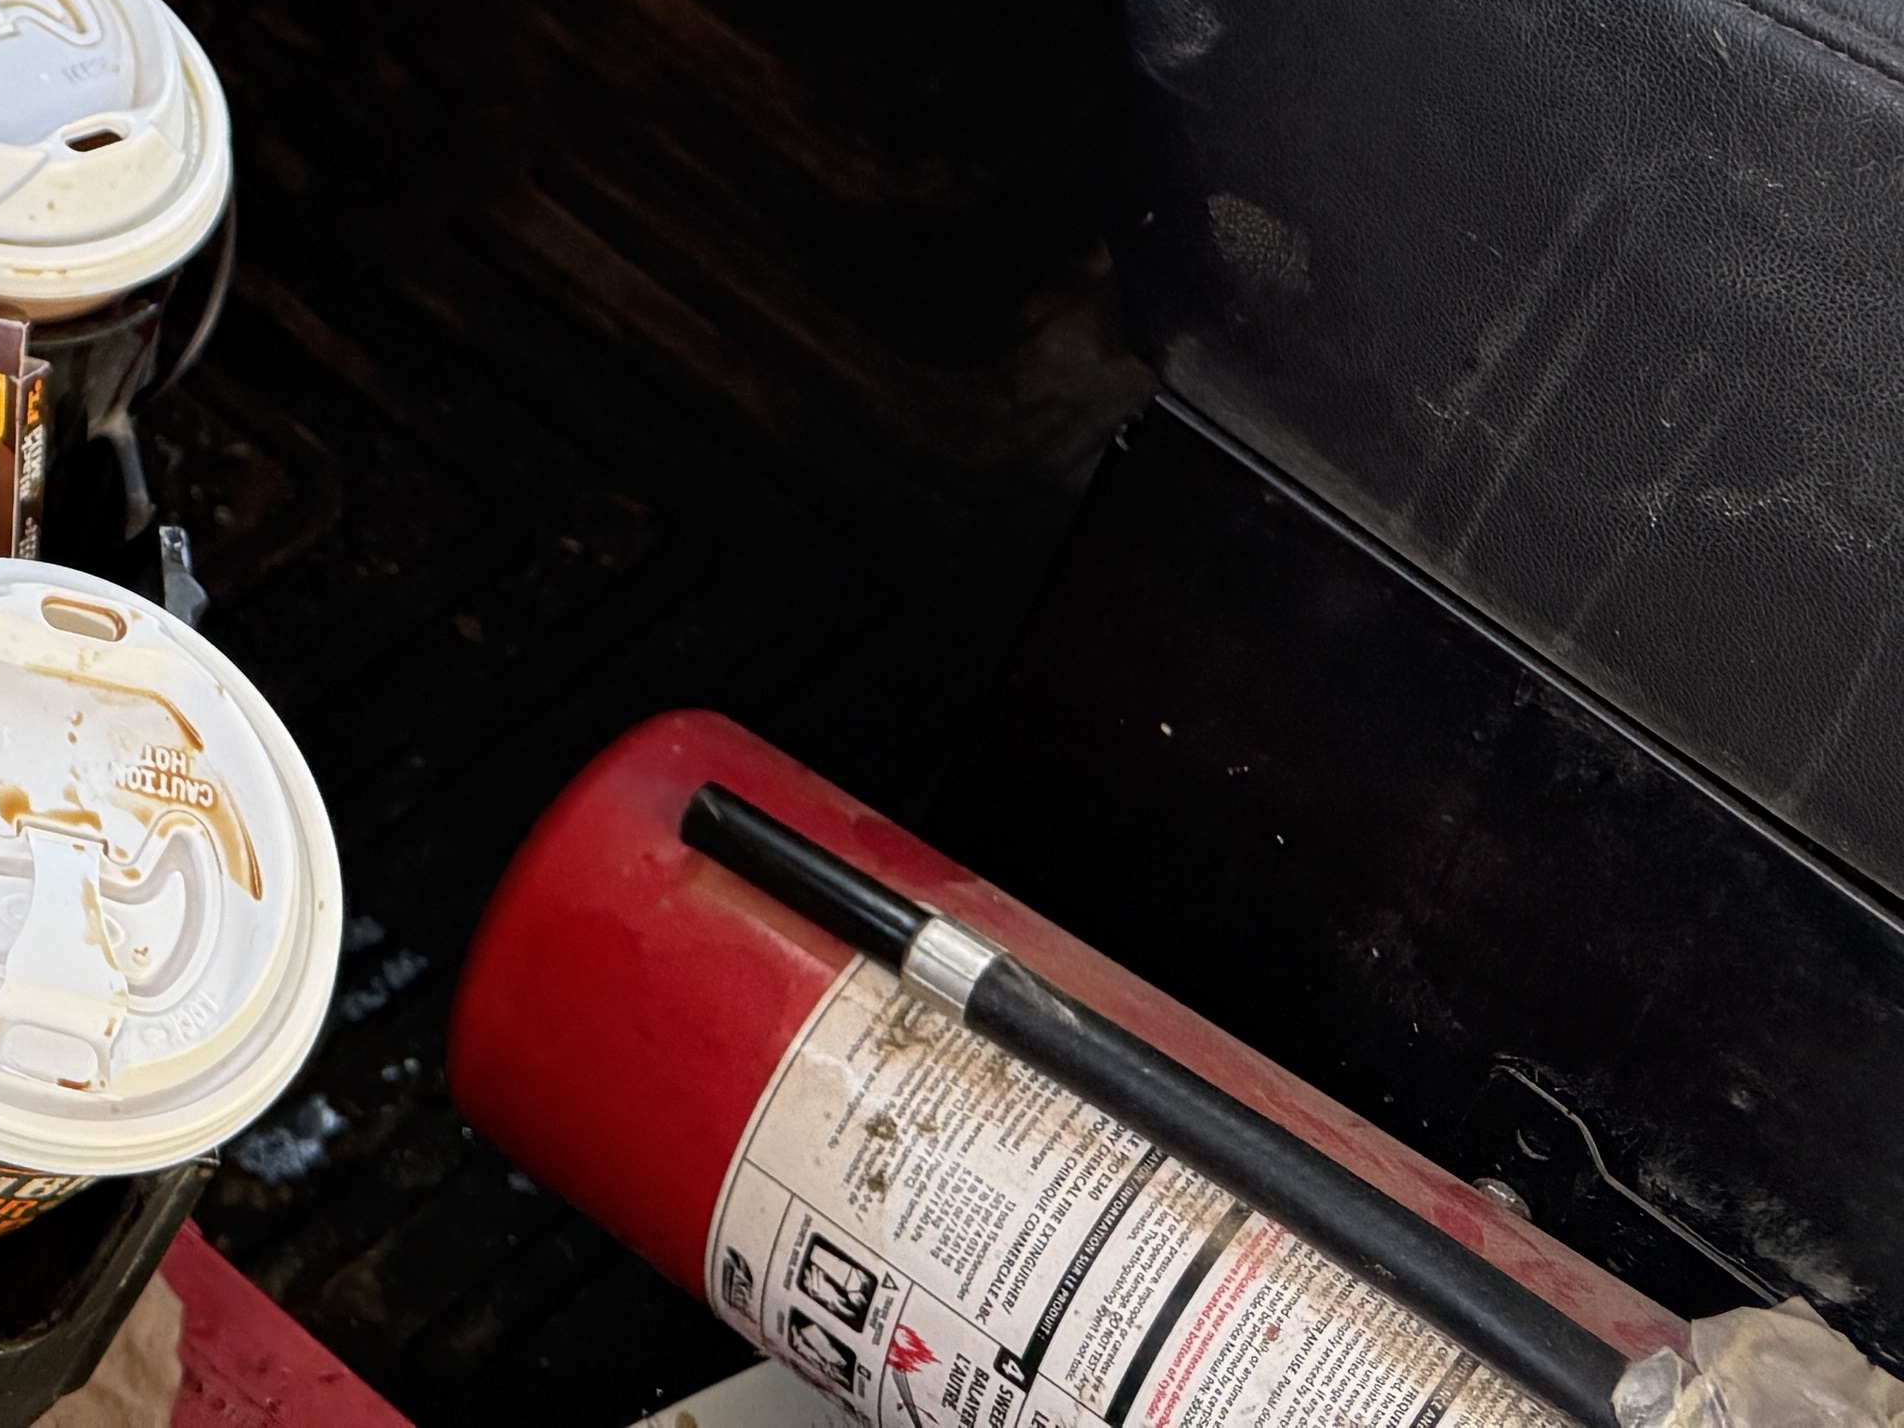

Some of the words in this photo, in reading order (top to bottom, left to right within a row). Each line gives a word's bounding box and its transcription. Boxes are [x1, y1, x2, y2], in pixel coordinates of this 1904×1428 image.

[1071, 1114, 1110, 1157] POUDRE
[1104, 1122, 1127, 1145] DRY
[1031, 1154, 1079, 1213] CHIMIQUE
[1064, 1142, 1111, 1198] CHEMICAL
[1086, 1172, 1112, 1201] E340
[1047, 1196, 1072, 1223] FIRE
[1140, 1228, 1158, 1247] The
[986, 1211, 1041, 1298] COMMERCIALE
[999, 1222, 1056, 1314] EXTINGUISHER/
[1070, 1253, 1089, 1276] SUR
[1063, 1274, 1077, 1289] LE
[1101, 1243, 1147, 1305] extinguishing
[974, 1296, 995, 1324] ABC
[1121, 1284, 1155, 1329] Improper
[1201, 1283, 1230, 1318] located
[1096, 1328, 1114, 1350] NOT
[1228, 1309, 1256, 1342] Service
[1075, 1340, 1090, 1358] not
[1207, 1341, 1234, 1377] Manual
[1222, 1322, 1262, 1375] performed
[1298, 1332, 1318, 1355] ANY
[999, 1357, 1028, 1382] 4
